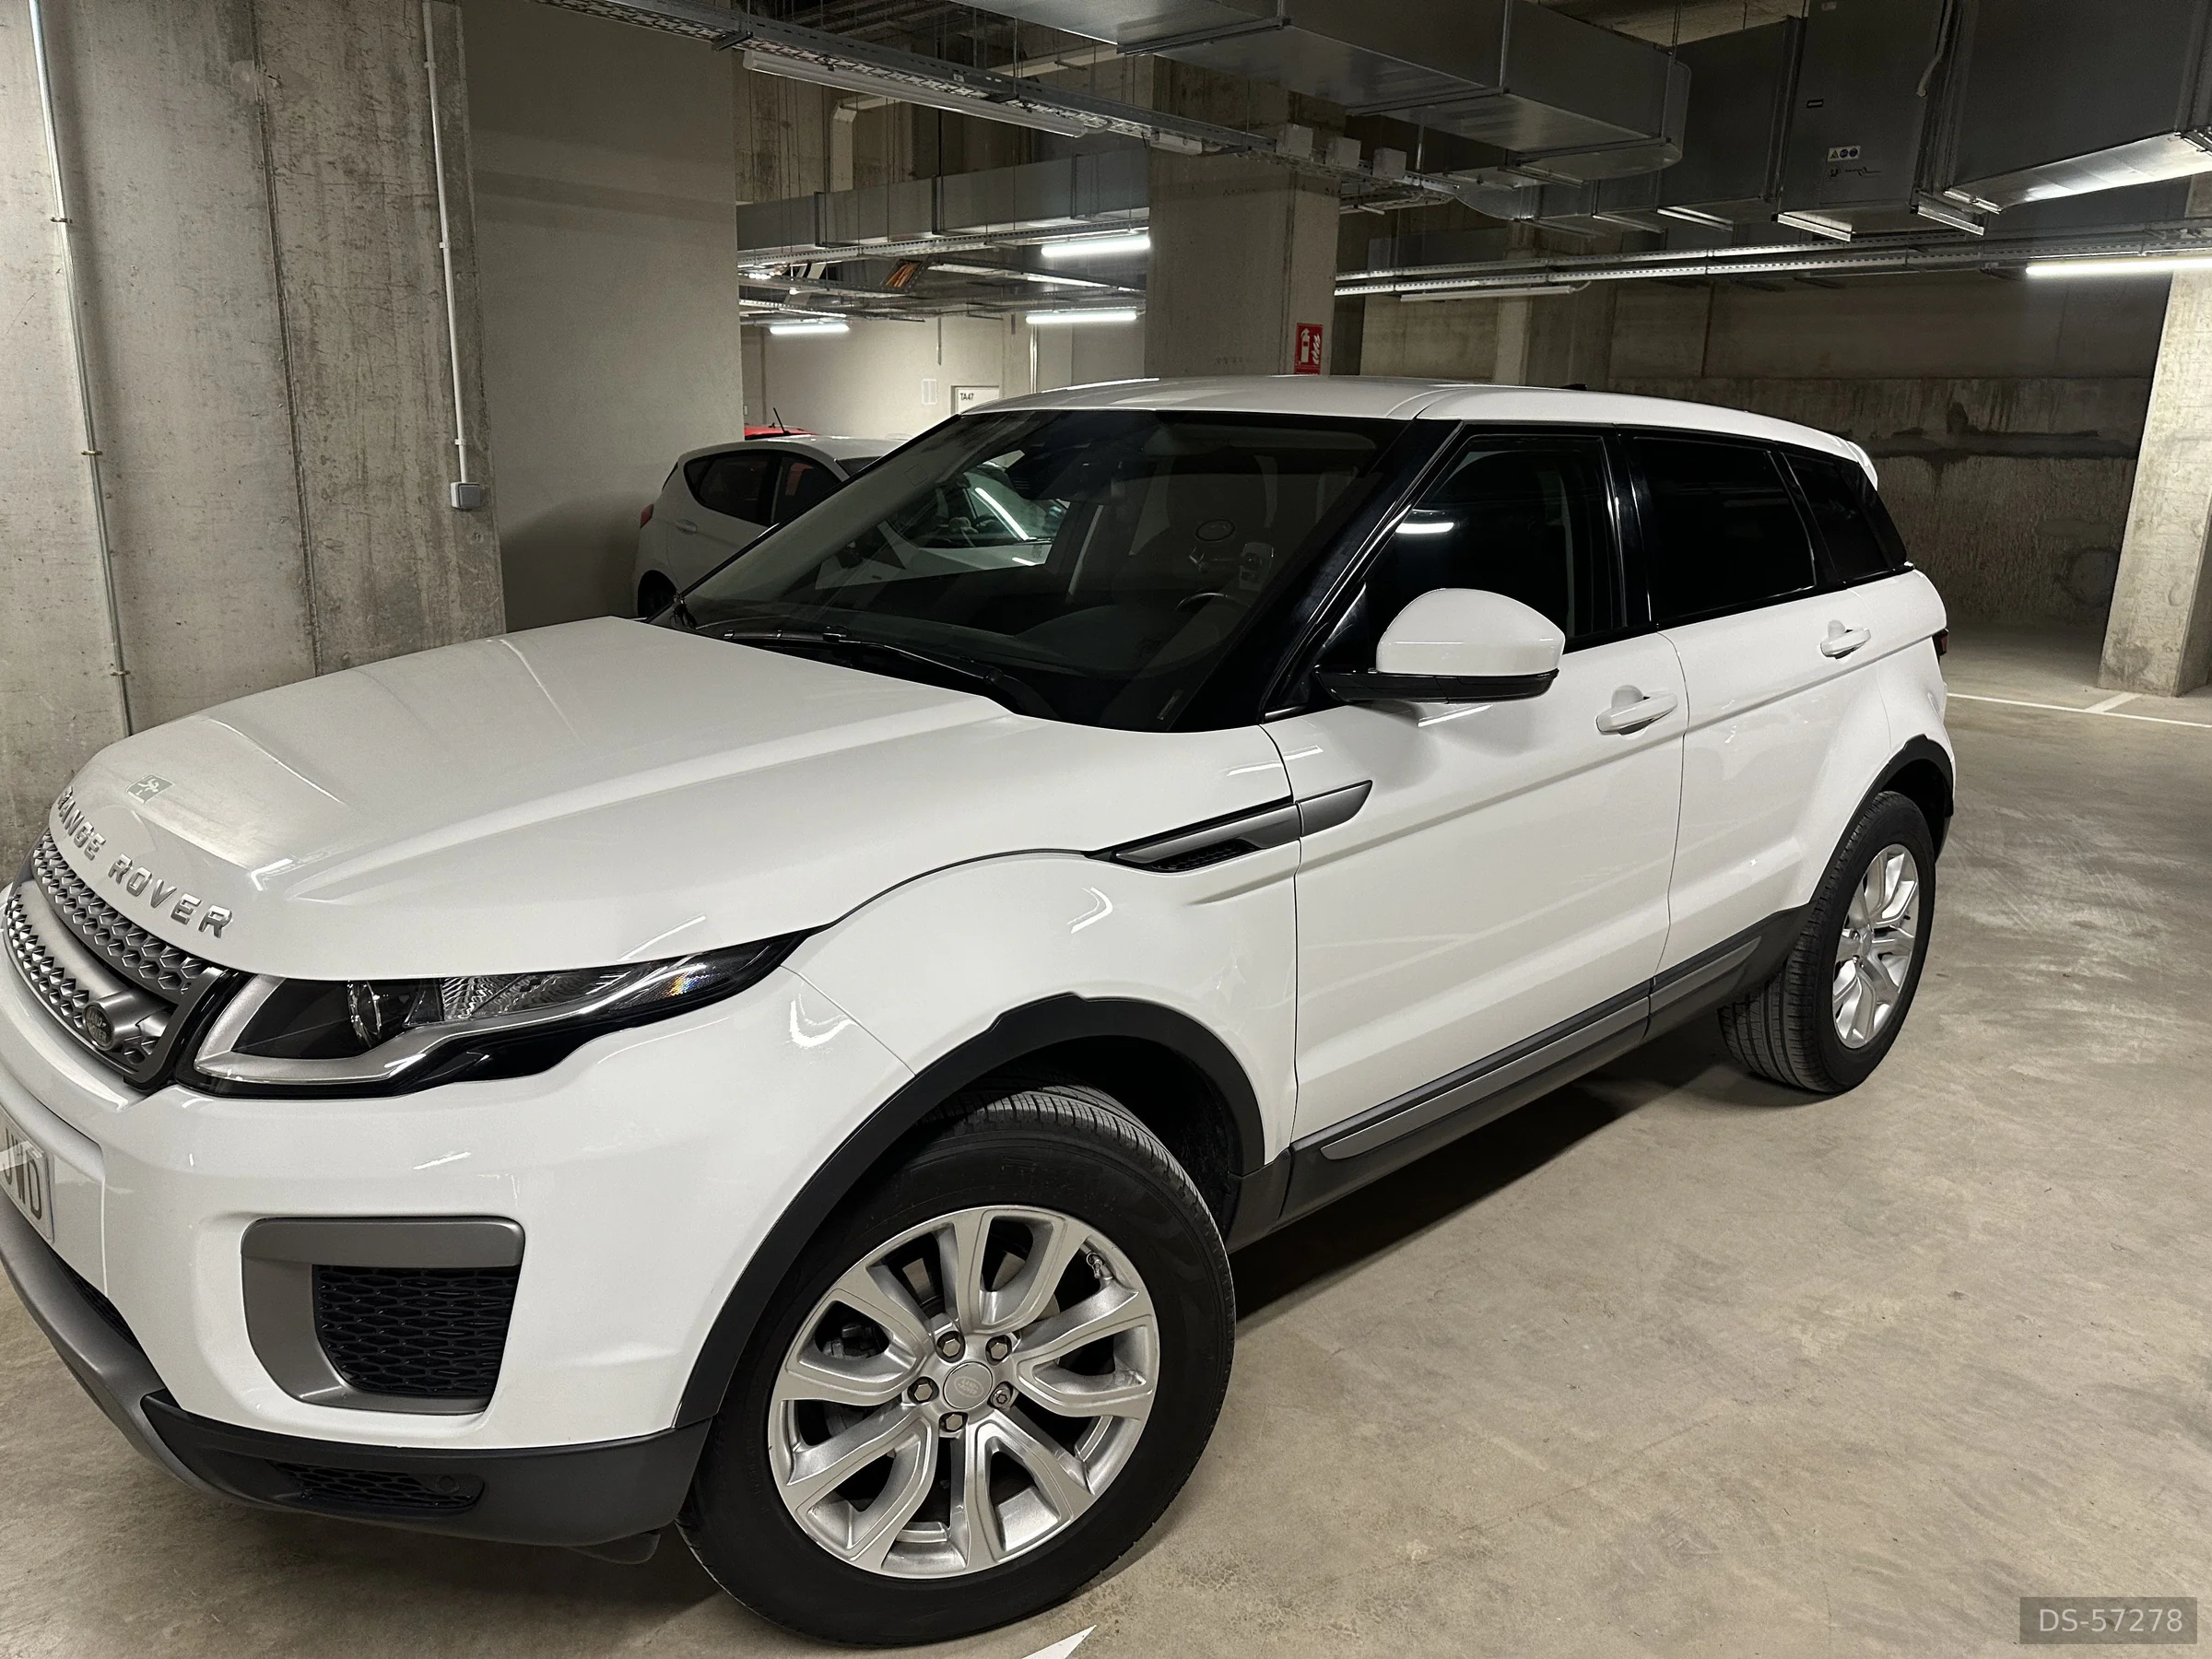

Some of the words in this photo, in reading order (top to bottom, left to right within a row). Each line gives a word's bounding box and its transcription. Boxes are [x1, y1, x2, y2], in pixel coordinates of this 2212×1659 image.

[959, 393, 974, 401] TA47
[58, 786, 106, 860] RANGE
[108, 853, 232, 938] ROVER
